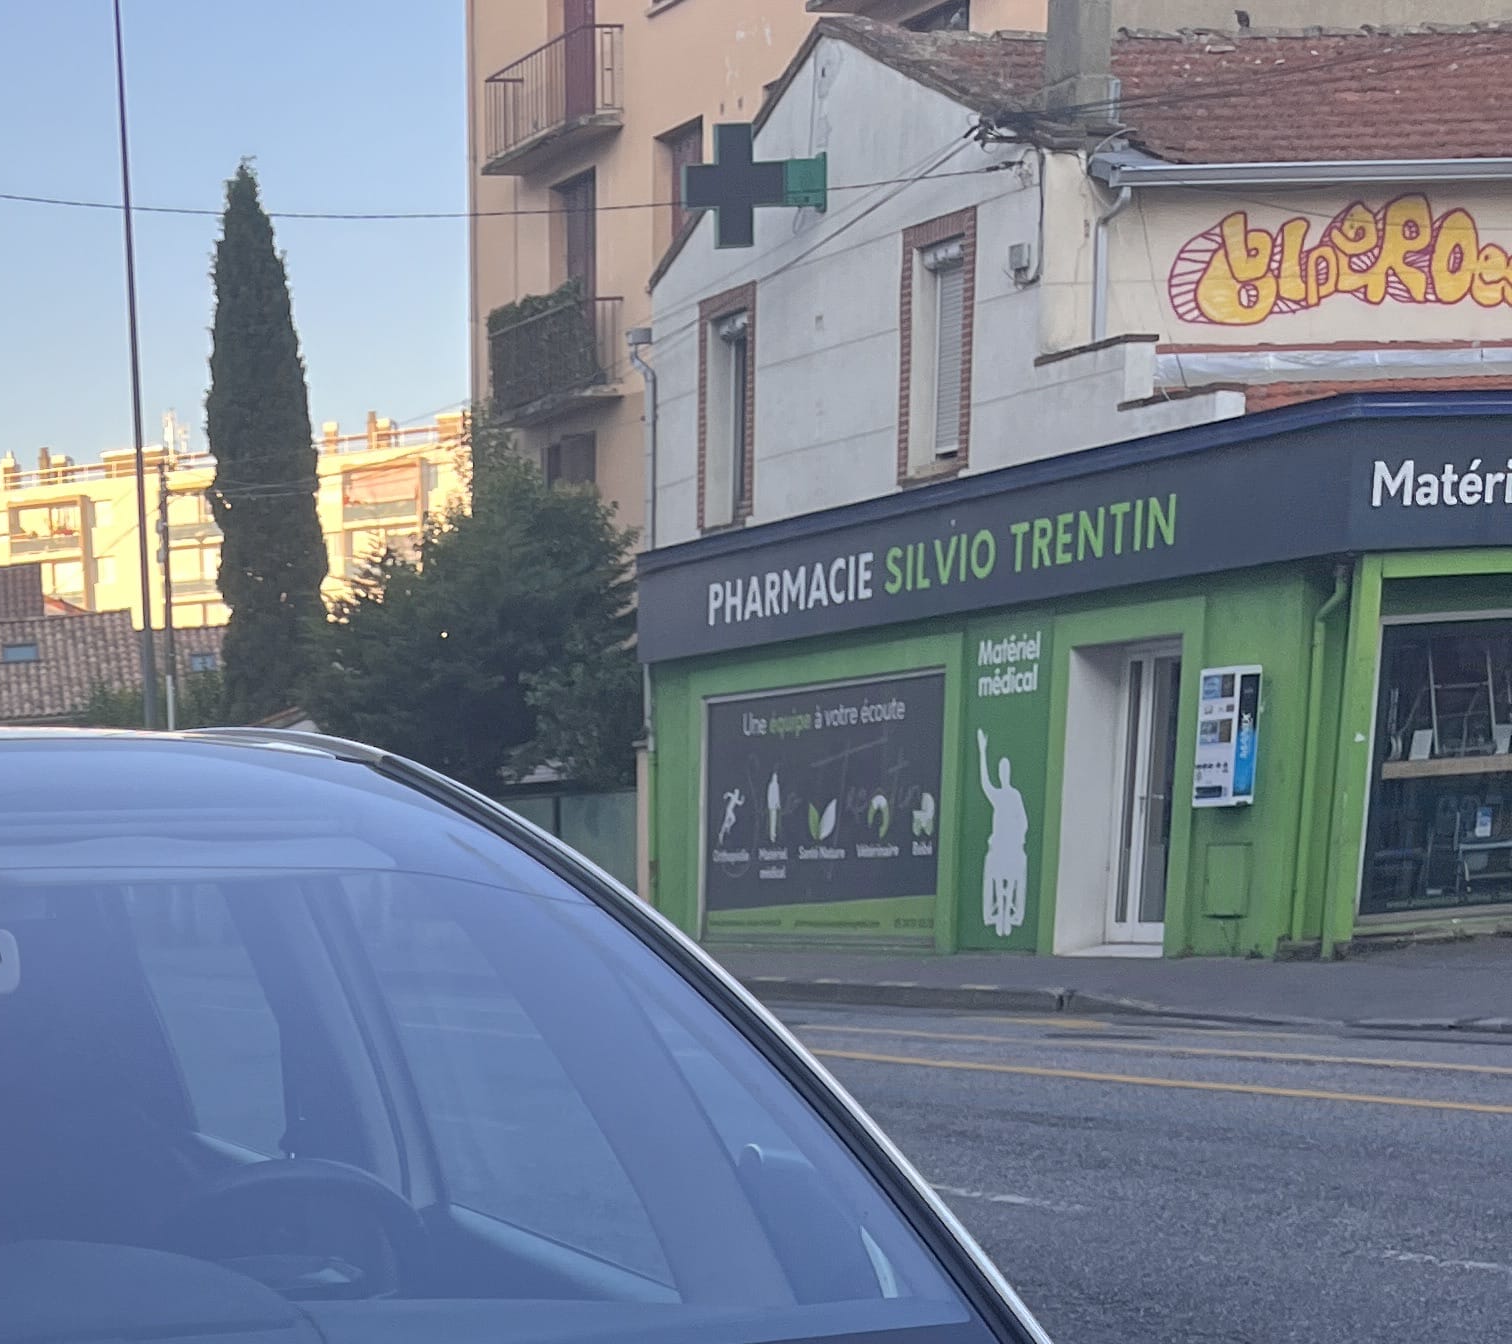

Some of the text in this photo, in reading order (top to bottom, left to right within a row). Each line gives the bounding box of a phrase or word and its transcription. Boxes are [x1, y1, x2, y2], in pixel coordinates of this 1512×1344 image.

[707, 493, 1177, 626] PHARMACIE SILVIO TRENTIN
[978, 630, 1042, 666] Matériel
[978, 663, 1039, 697] médical
[742, 712, 767, 736] Une
[824, 703, 858, 728] votre
[860, 698, 906, 722] écoute
